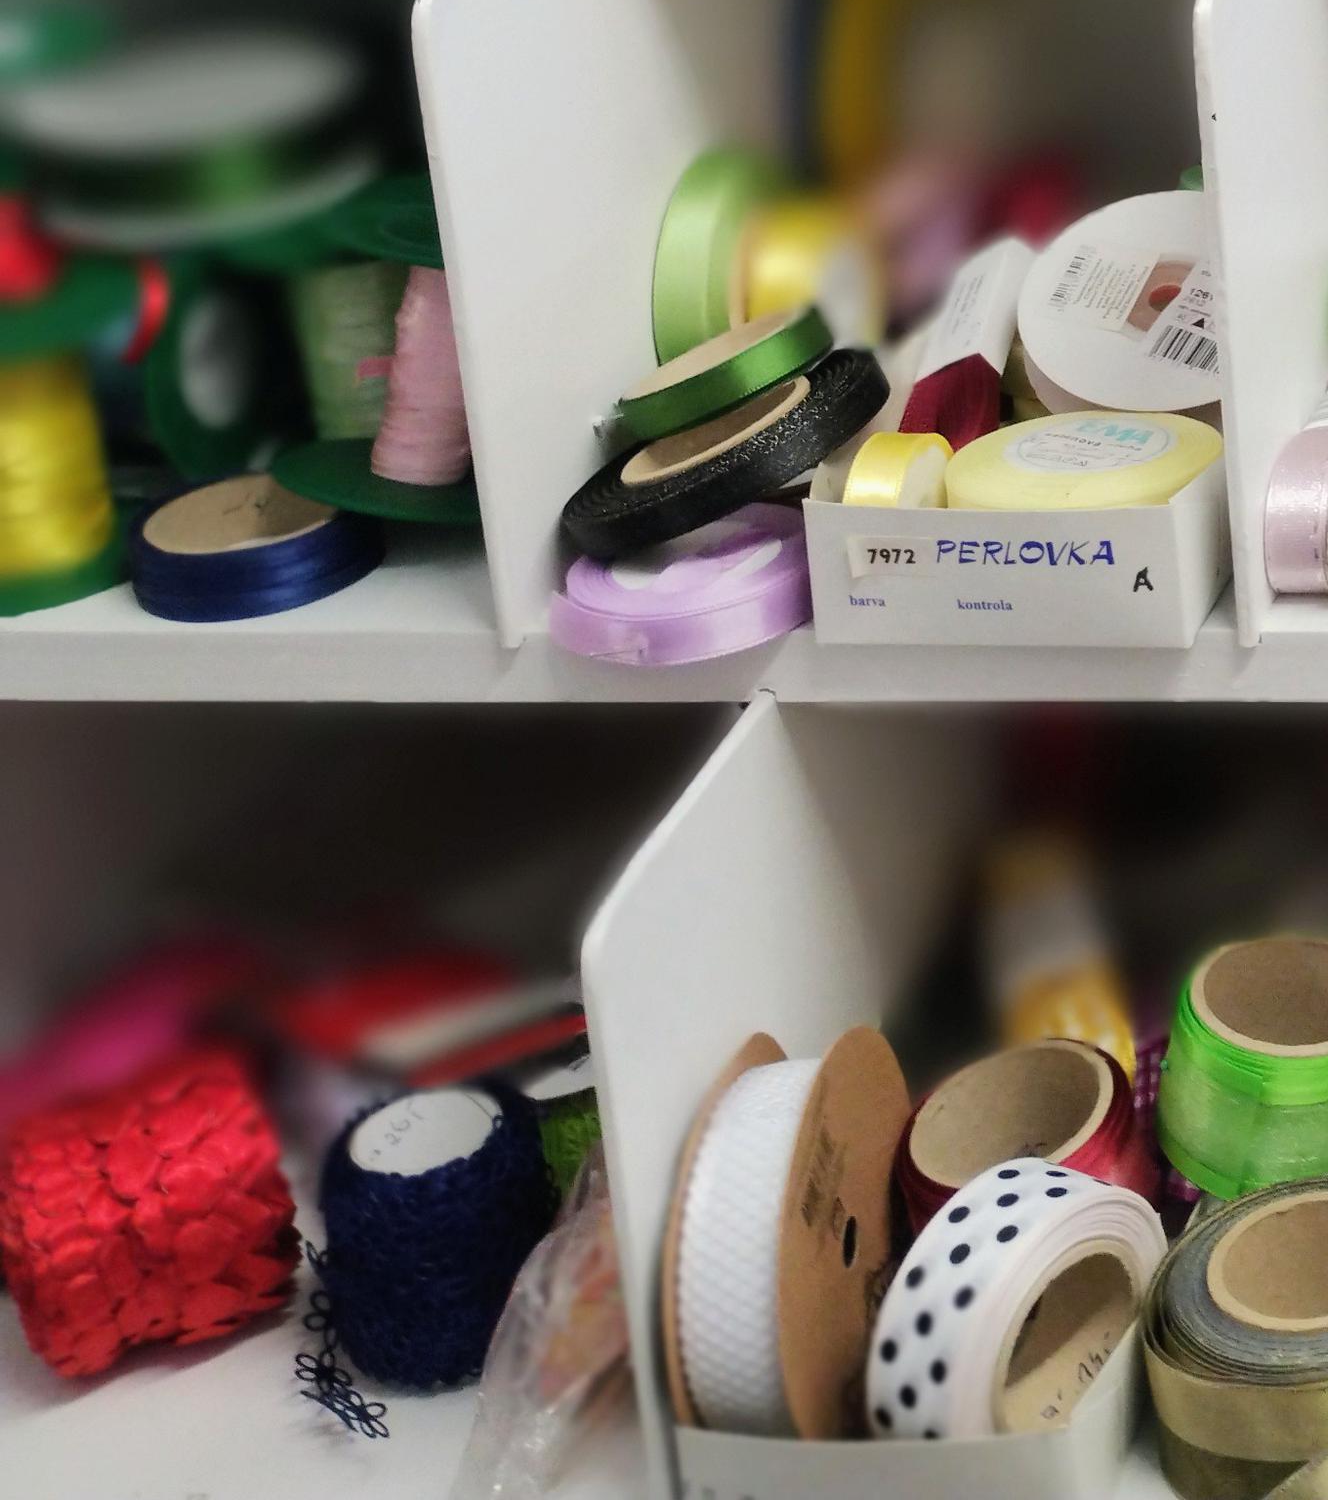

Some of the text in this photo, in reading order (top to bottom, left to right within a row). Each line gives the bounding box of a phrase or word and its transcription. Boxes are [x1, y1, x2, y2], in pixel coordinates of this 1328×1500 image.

[866, 547, 917, 565] 7972
[935, 538, 1116, 568] PERLOVKA
[1132, 566, 1154, 593] A
[848, 594, 887, 608] barva
[957, 597, 1014, 612] kontrola
